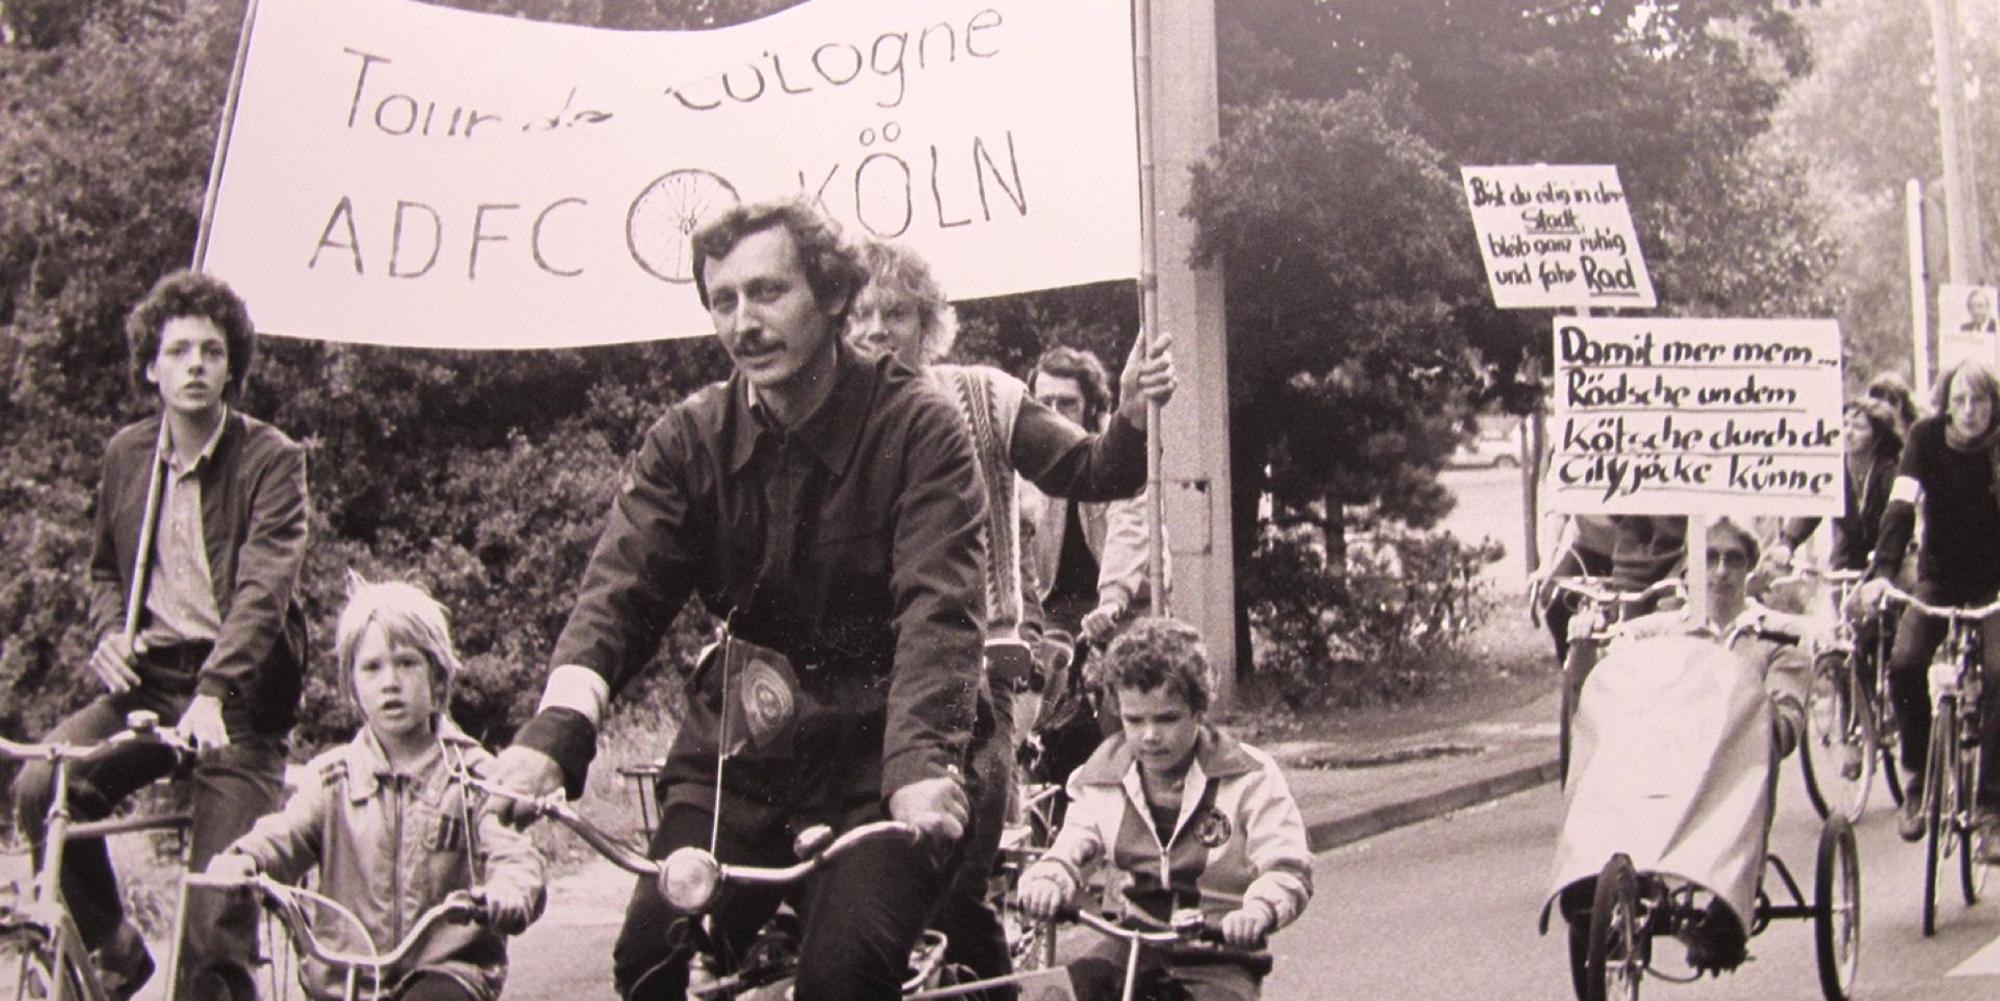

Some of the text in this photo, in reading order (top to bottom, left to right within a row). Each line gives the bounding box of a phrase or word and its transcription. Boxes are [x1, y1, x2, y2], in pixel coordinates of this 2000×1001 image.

[344, 47, 503, 138] Tour
[308, 121, 1027, 281] ADFC KÖLN
[1470, 176, 1506, 207] Bist
[1510, 184, 1532, 206] du
[1488, 227, 1627, 258] bleib ganz ruhig
[1495, 261, 1533, 285] und
[1580, 255, 1637, 294] Rad
[1560, 326, 1654, 366] Damit
[1662, 340, 1727, 363] mer
[1709, 417, 1797, 450] durch
[1802, 418, 1840, 449] de
[1559, 454, 1629, 504] City
